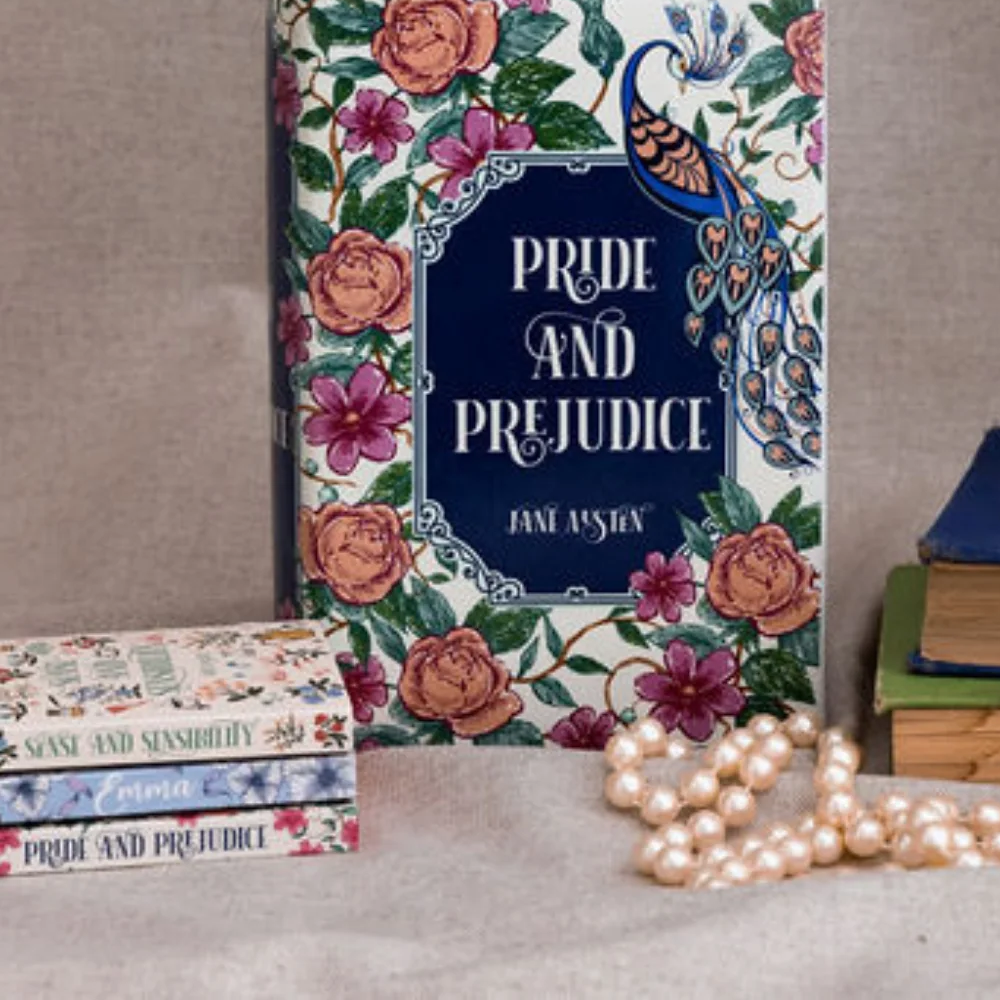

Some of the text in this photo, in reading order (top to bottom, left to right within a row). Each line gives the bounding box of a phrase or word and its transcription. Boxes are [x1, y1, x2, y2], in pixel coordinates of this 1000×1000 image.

[510, 236, 657, 304] PRIDE
[525, 307, 636, 380] AND
[453, 397, 712, 468] PREJUDICE
[507, 505, 558, 534] JANE
[24, 721, 258, 758] SENSE AND SENSIBILITY
[94, 774, 196, 816] Emma
[23, 824, 269, 868] PRIDE AND PREJUDICE
